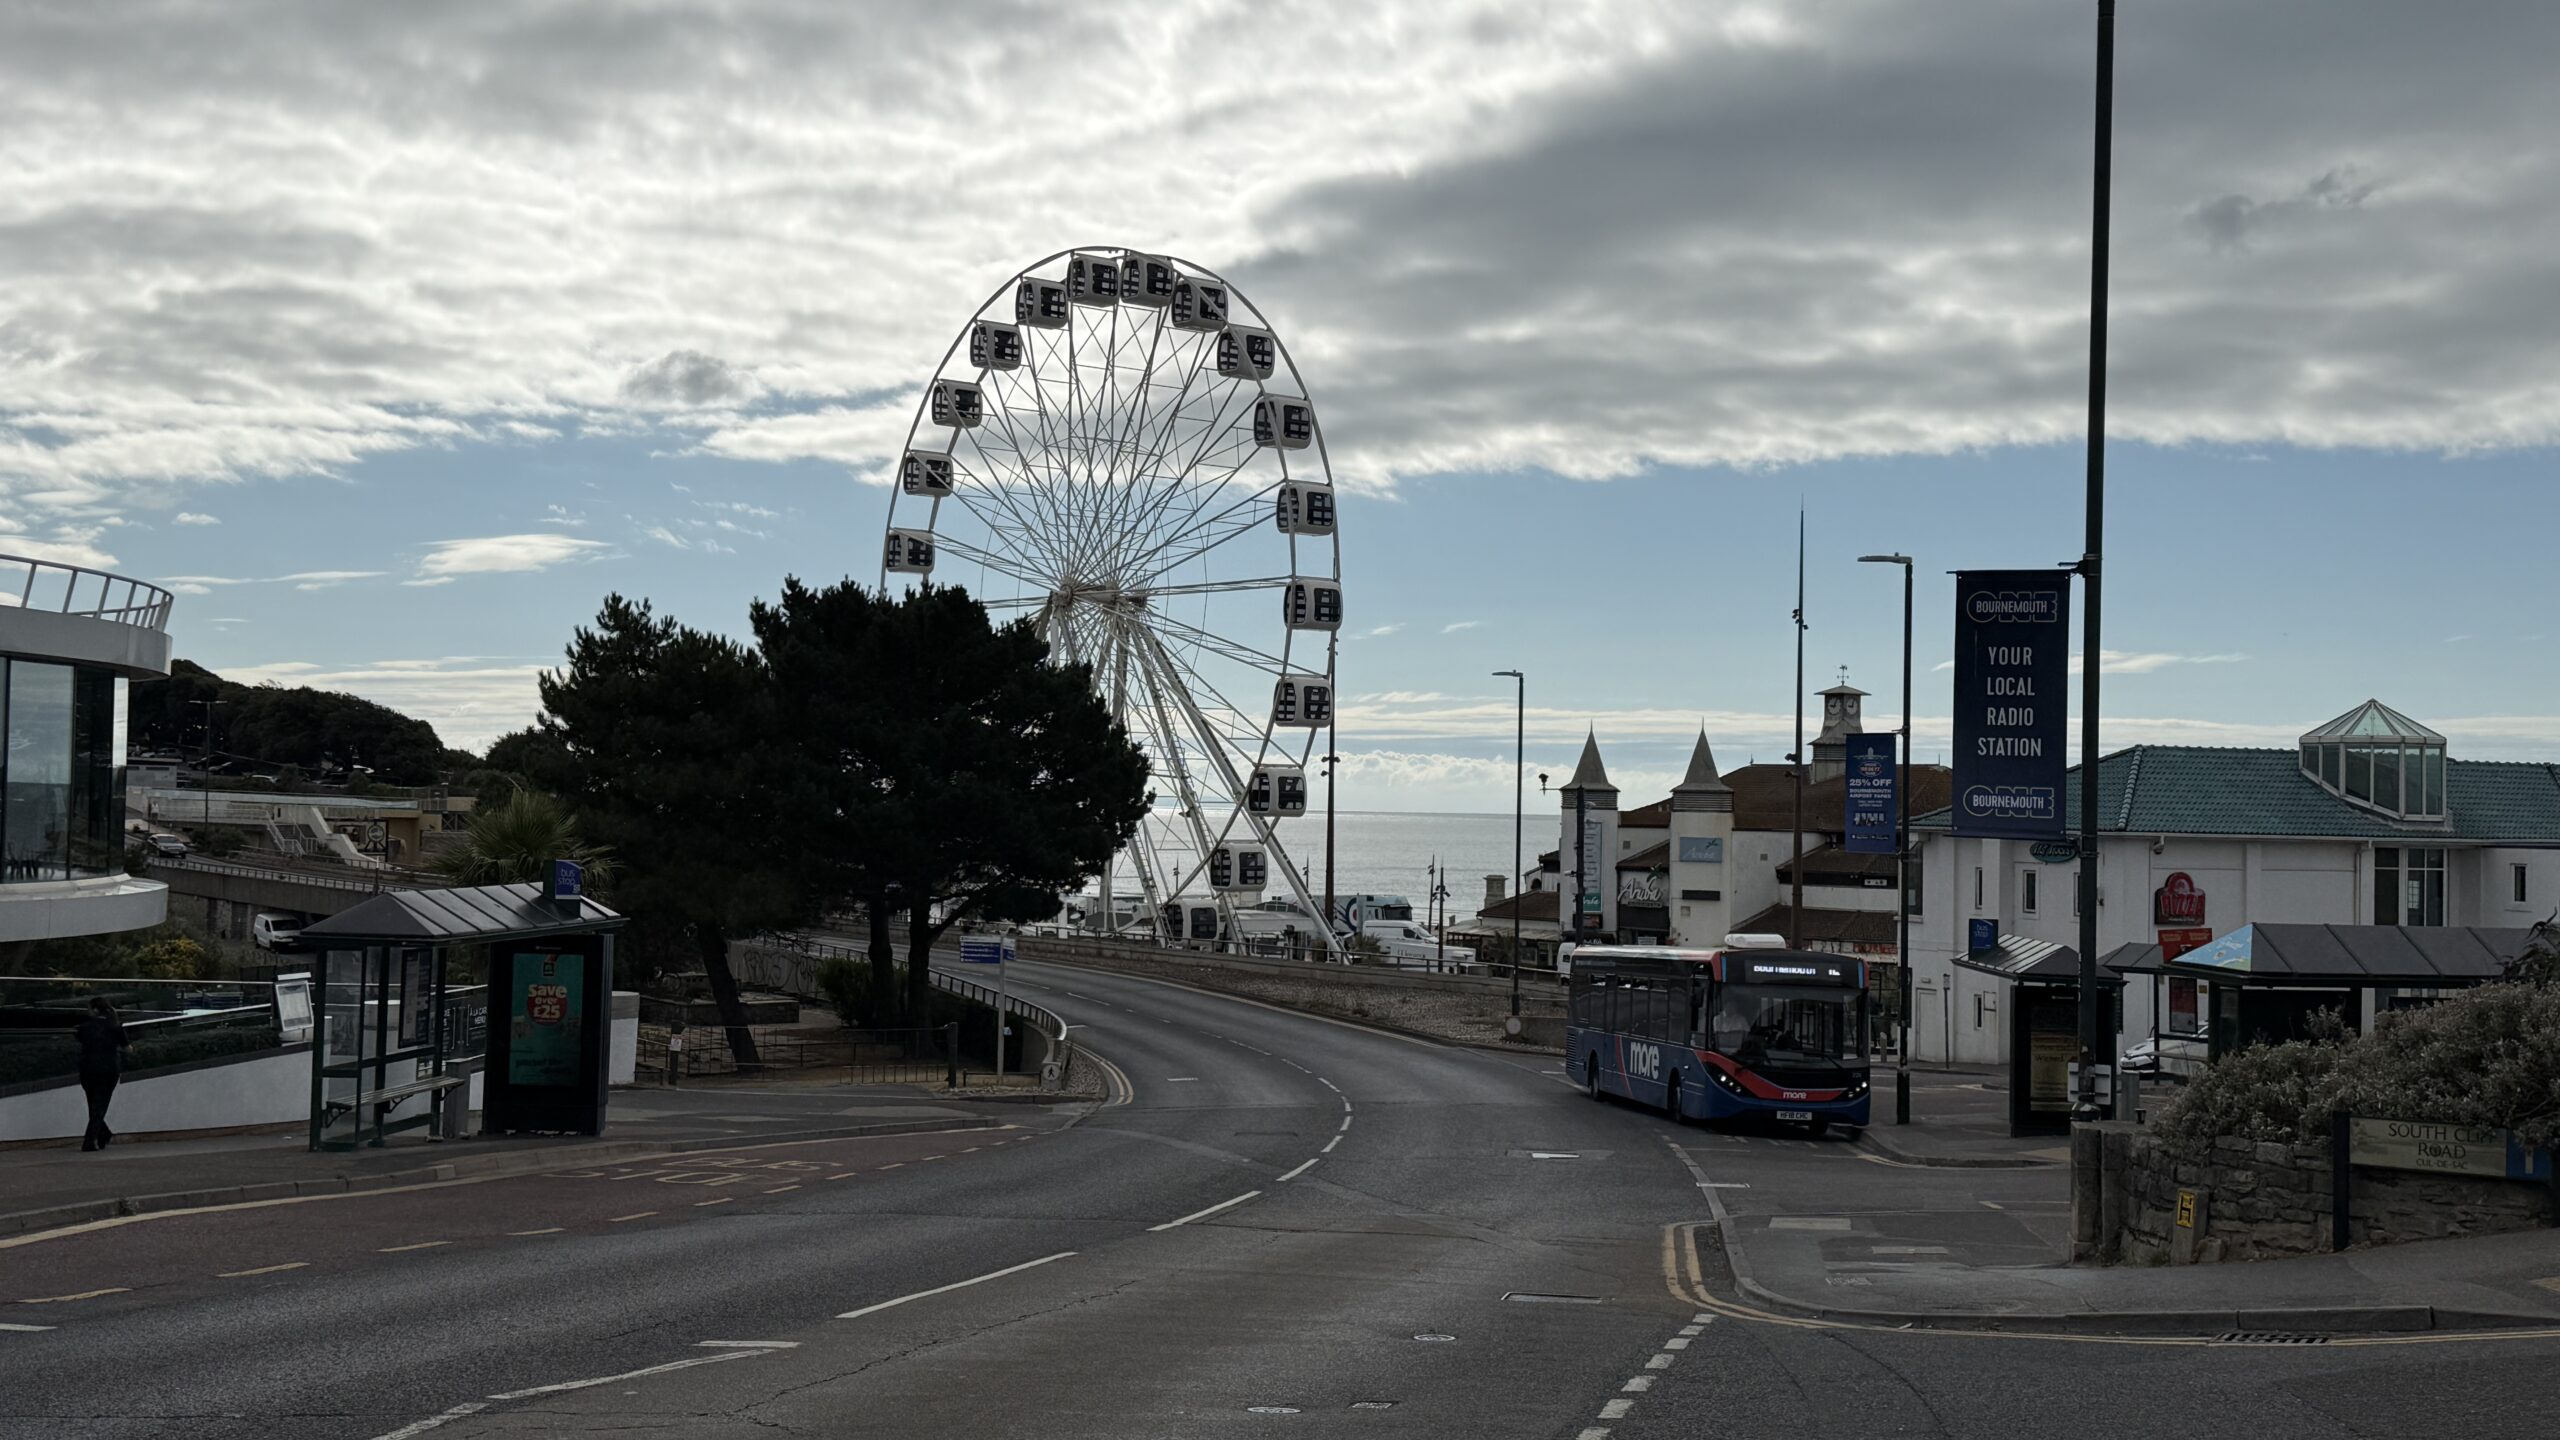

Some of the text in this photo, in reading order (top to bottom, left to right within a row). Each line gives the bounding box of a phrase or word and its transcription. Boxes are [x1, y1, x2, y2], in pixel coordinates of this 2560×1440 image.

[1975, 599, 2048, 614] BOURNEMOUTH
[1987, 646, 2033, 666] YOUR
[1986, 676, 2036, 696] LOCAL
[1986, 706, 2034, 727] RADIO
[1977, 736, 2043, 757] STATION
[1872, 778, 1892, 787] OFF
[1972, 794, 2045, 809] BOURNEMOUTH
[560, 867, 576, 877] bus
[557, 877, 576, 887] stop
[1617, 876, 1663, 903] Aruba
[532, 1004, 561, 1019] £25
[1629, 1041, 1660, 1080] more
[1782, 1091, 1807, 1100] more
[2388, 1122, 2447, 1141] SOUTH
[2417, 1142, 2466, 1160] ROAD
[661, 1156, 844, 1172] BUS
